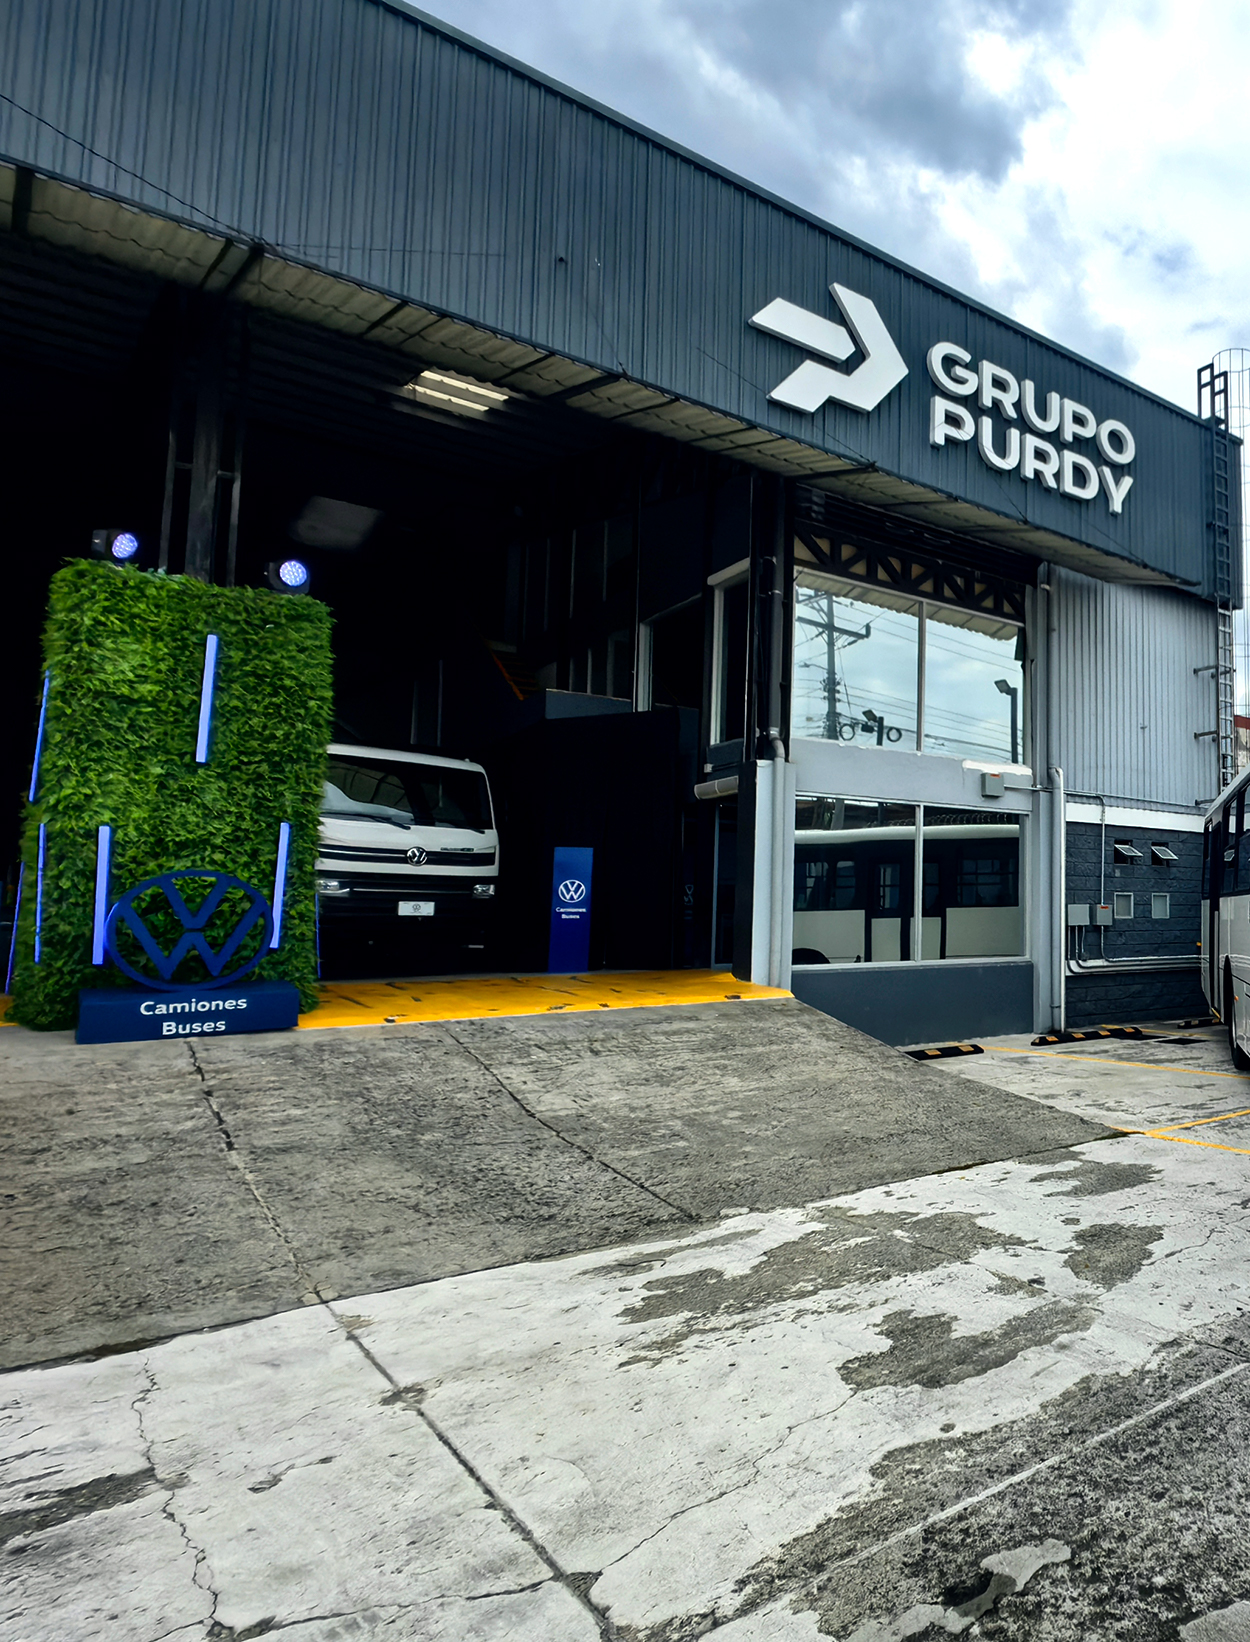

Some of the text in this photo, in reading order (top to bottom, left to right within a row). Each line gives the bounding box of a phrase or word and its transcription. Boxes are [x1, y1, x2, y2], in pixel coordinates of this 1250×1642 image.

[926, 341, 1136, 466] GRUPO
[929, 395, 1134, 516] PURDY
[139, 998, 248, 1016] Camiones
[162, 1020, 227, 1036] Buses
